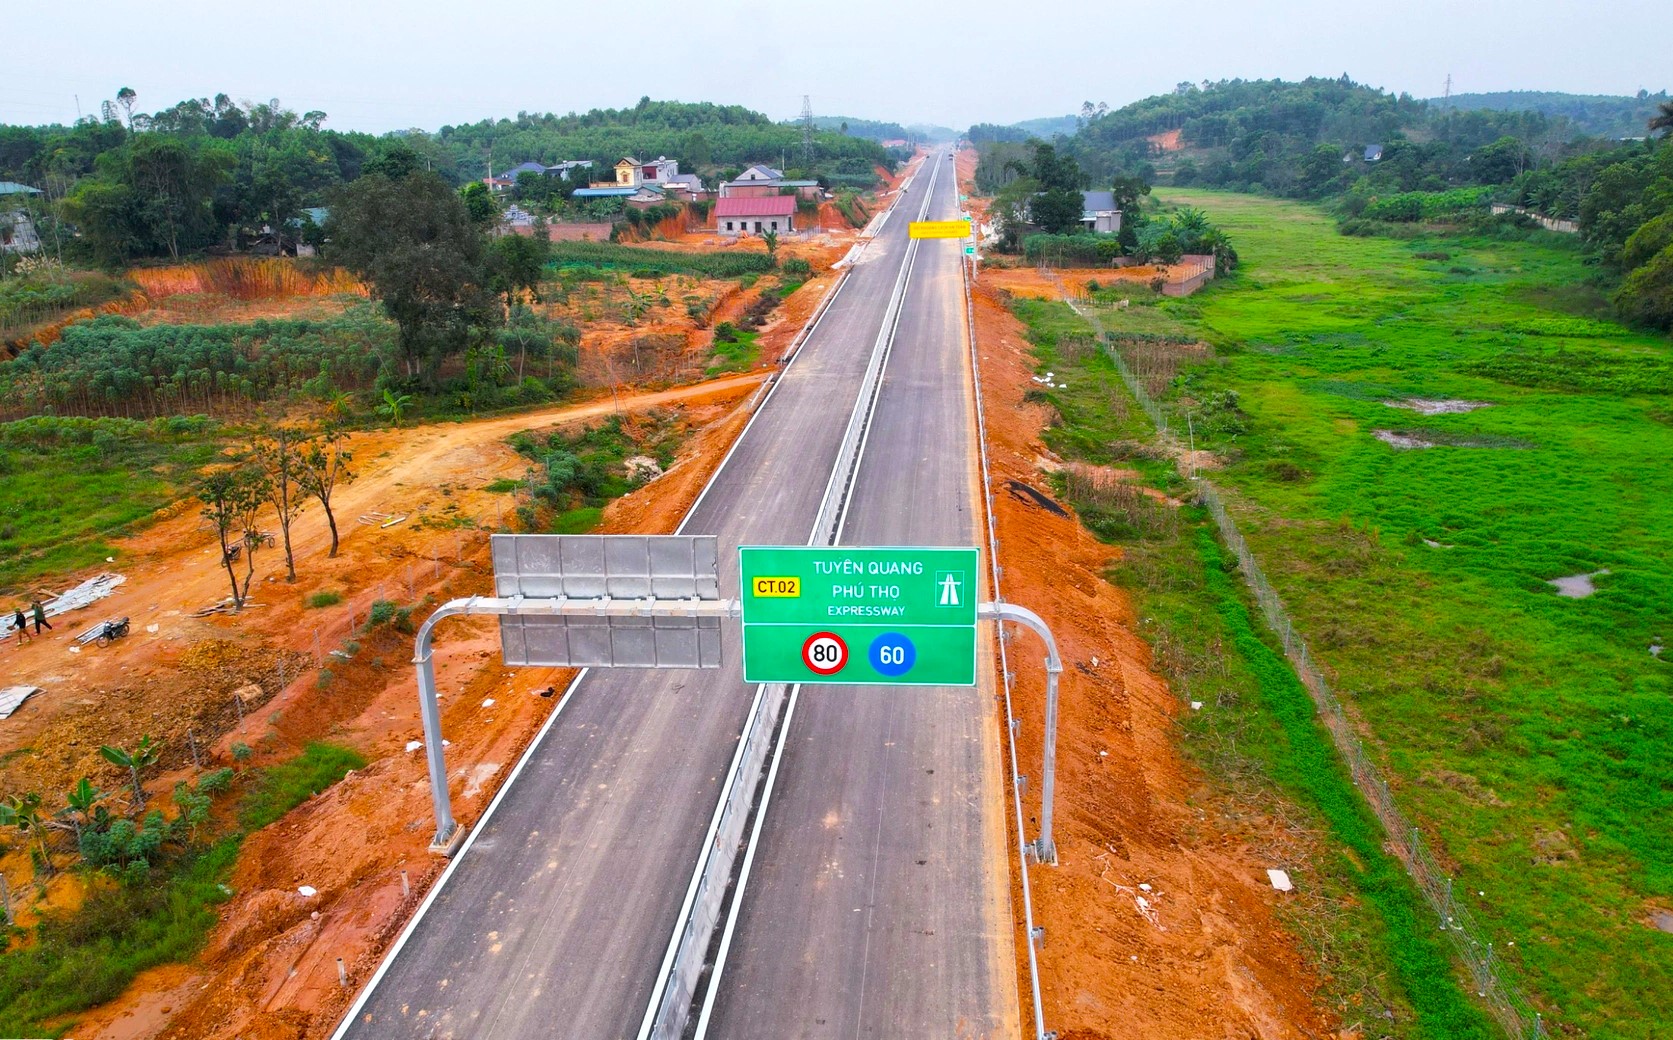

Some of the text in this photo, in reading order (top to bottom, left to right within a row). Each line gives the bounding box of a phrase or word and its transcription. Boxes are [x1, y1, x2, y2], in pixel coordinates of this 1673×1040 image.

[813, 559, 923, 575] TUYÊN QUANG
[757, 581, 796, 594] CT.02
[832, 582, 900, 601] PHÚ THỌ
[827, 606, 905, 616] EXPRESSWAY
[813, 644, 838, 662] 80
[880, 646, 905, 665] 60
